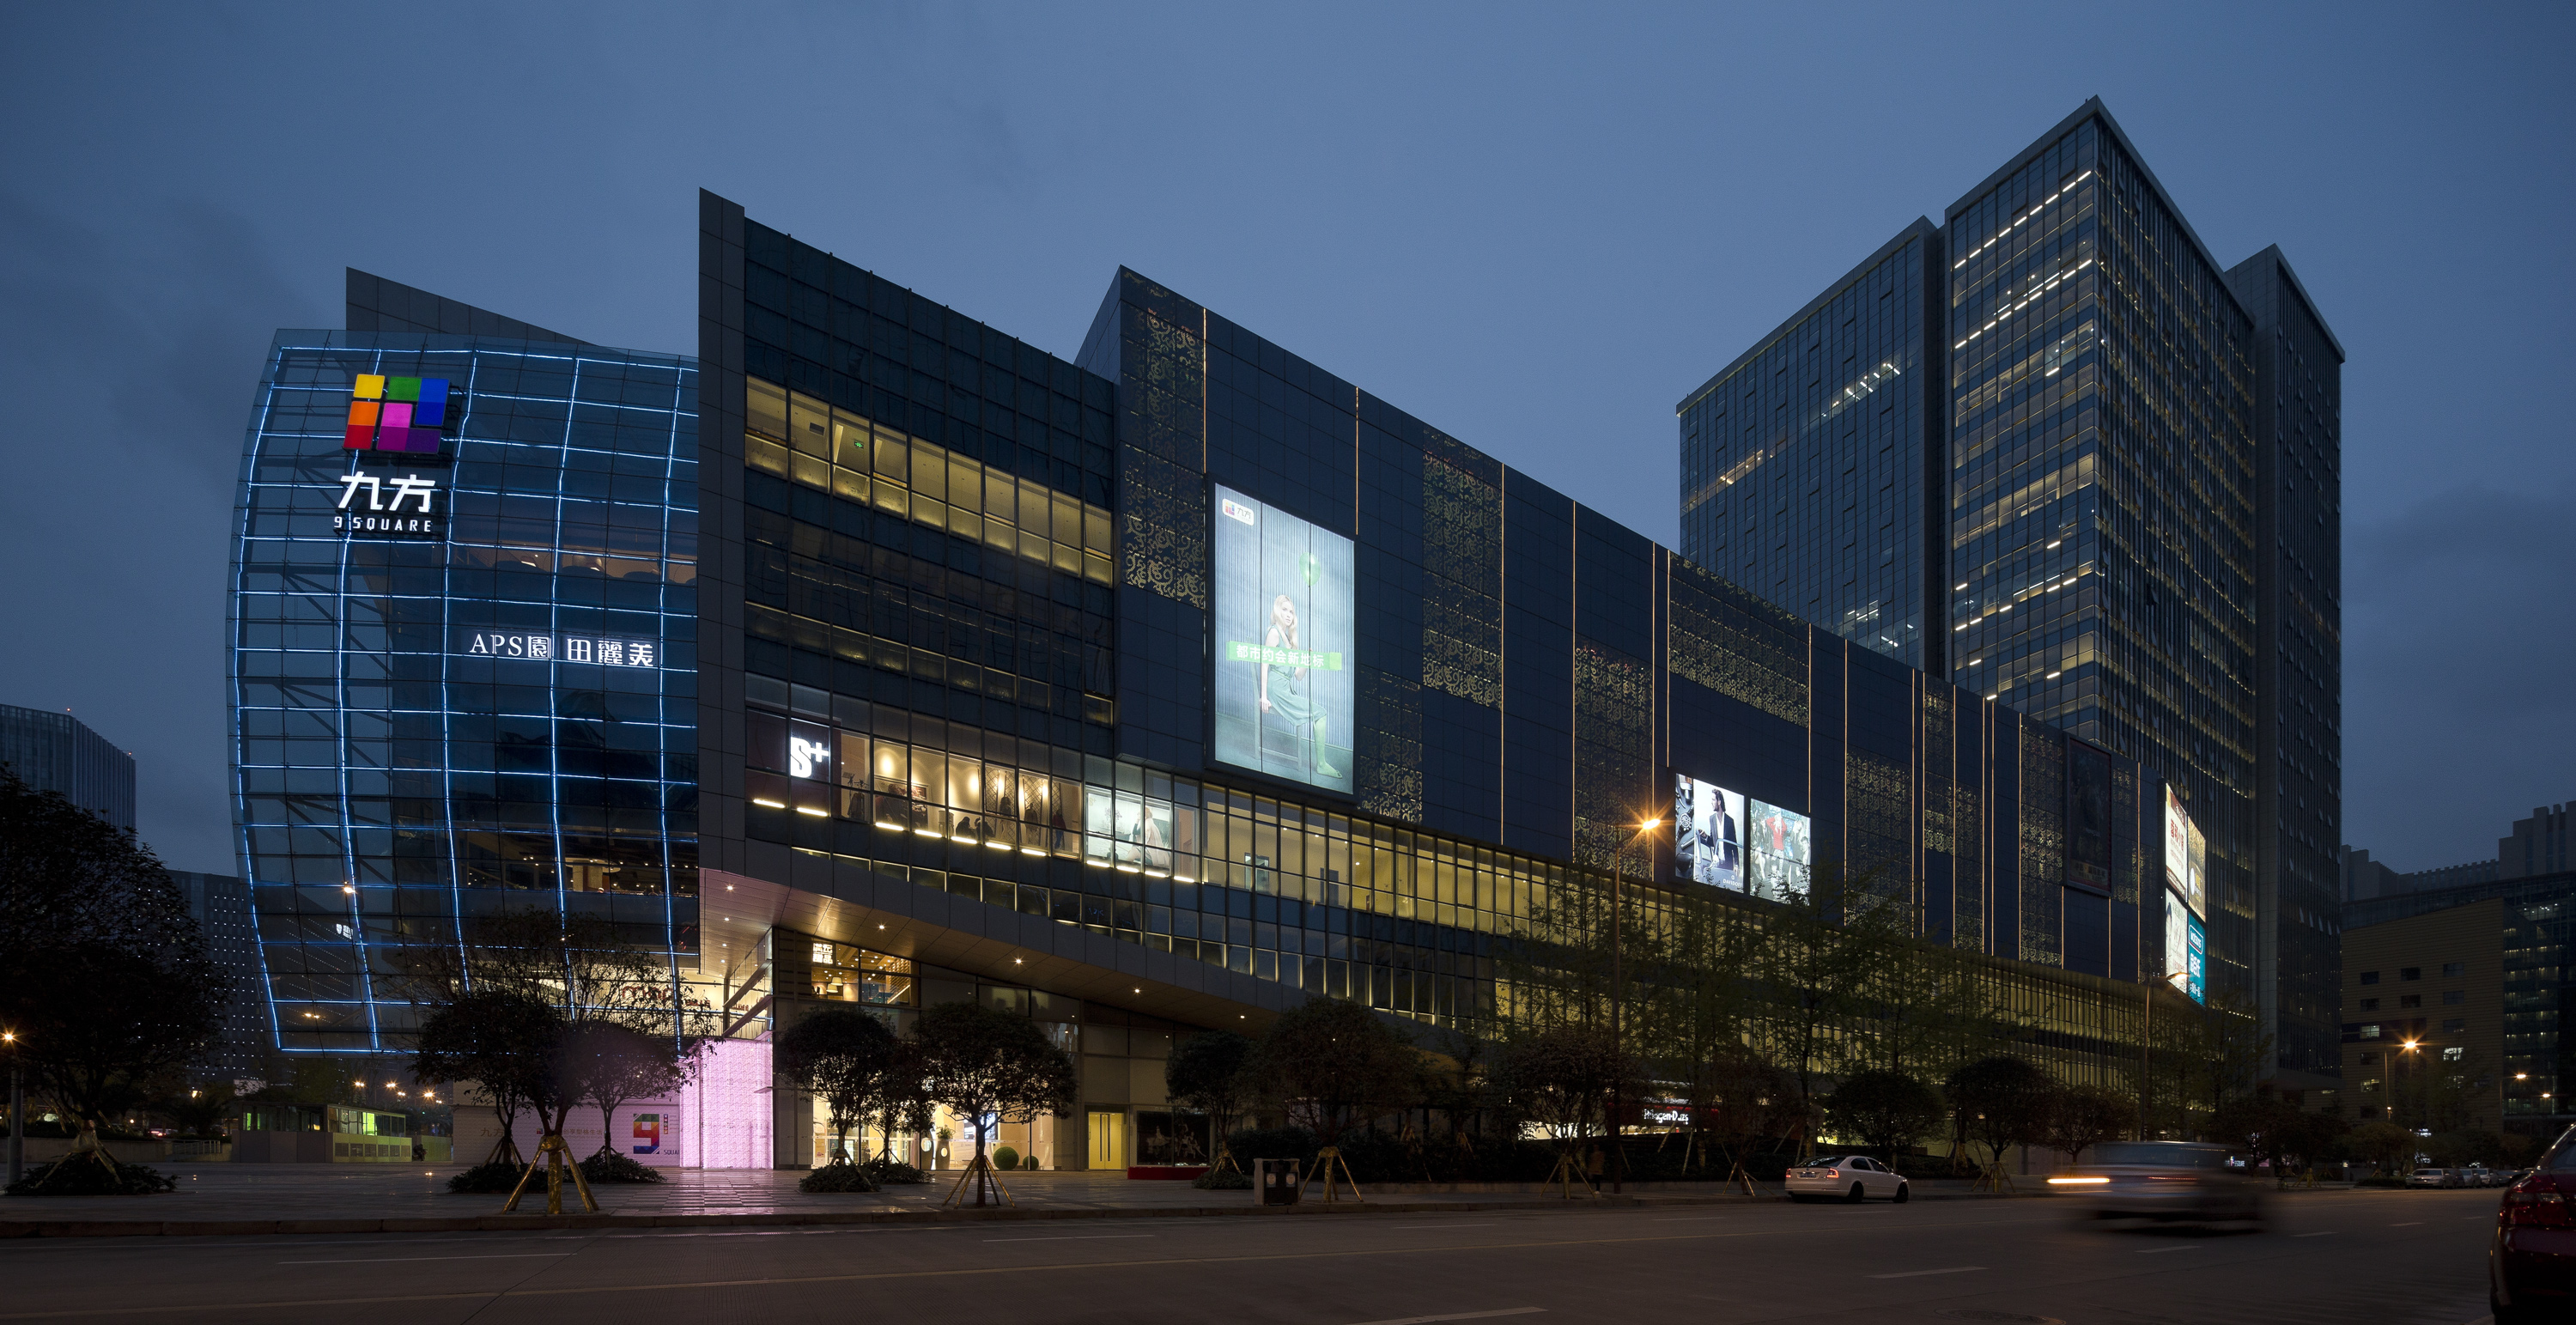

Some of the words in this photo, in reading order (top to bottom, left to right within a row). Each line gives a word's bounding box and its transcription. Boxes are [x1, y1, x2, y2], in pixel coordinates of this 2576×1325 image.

[338, 471, 435, 513] 九方
[334, 516, 343, 528] 9
[353, 517, 431, 532] SQUARE
[1236, 644, 1324, 667] 都市约会新地标
[791, 737, 829, 778] S+
